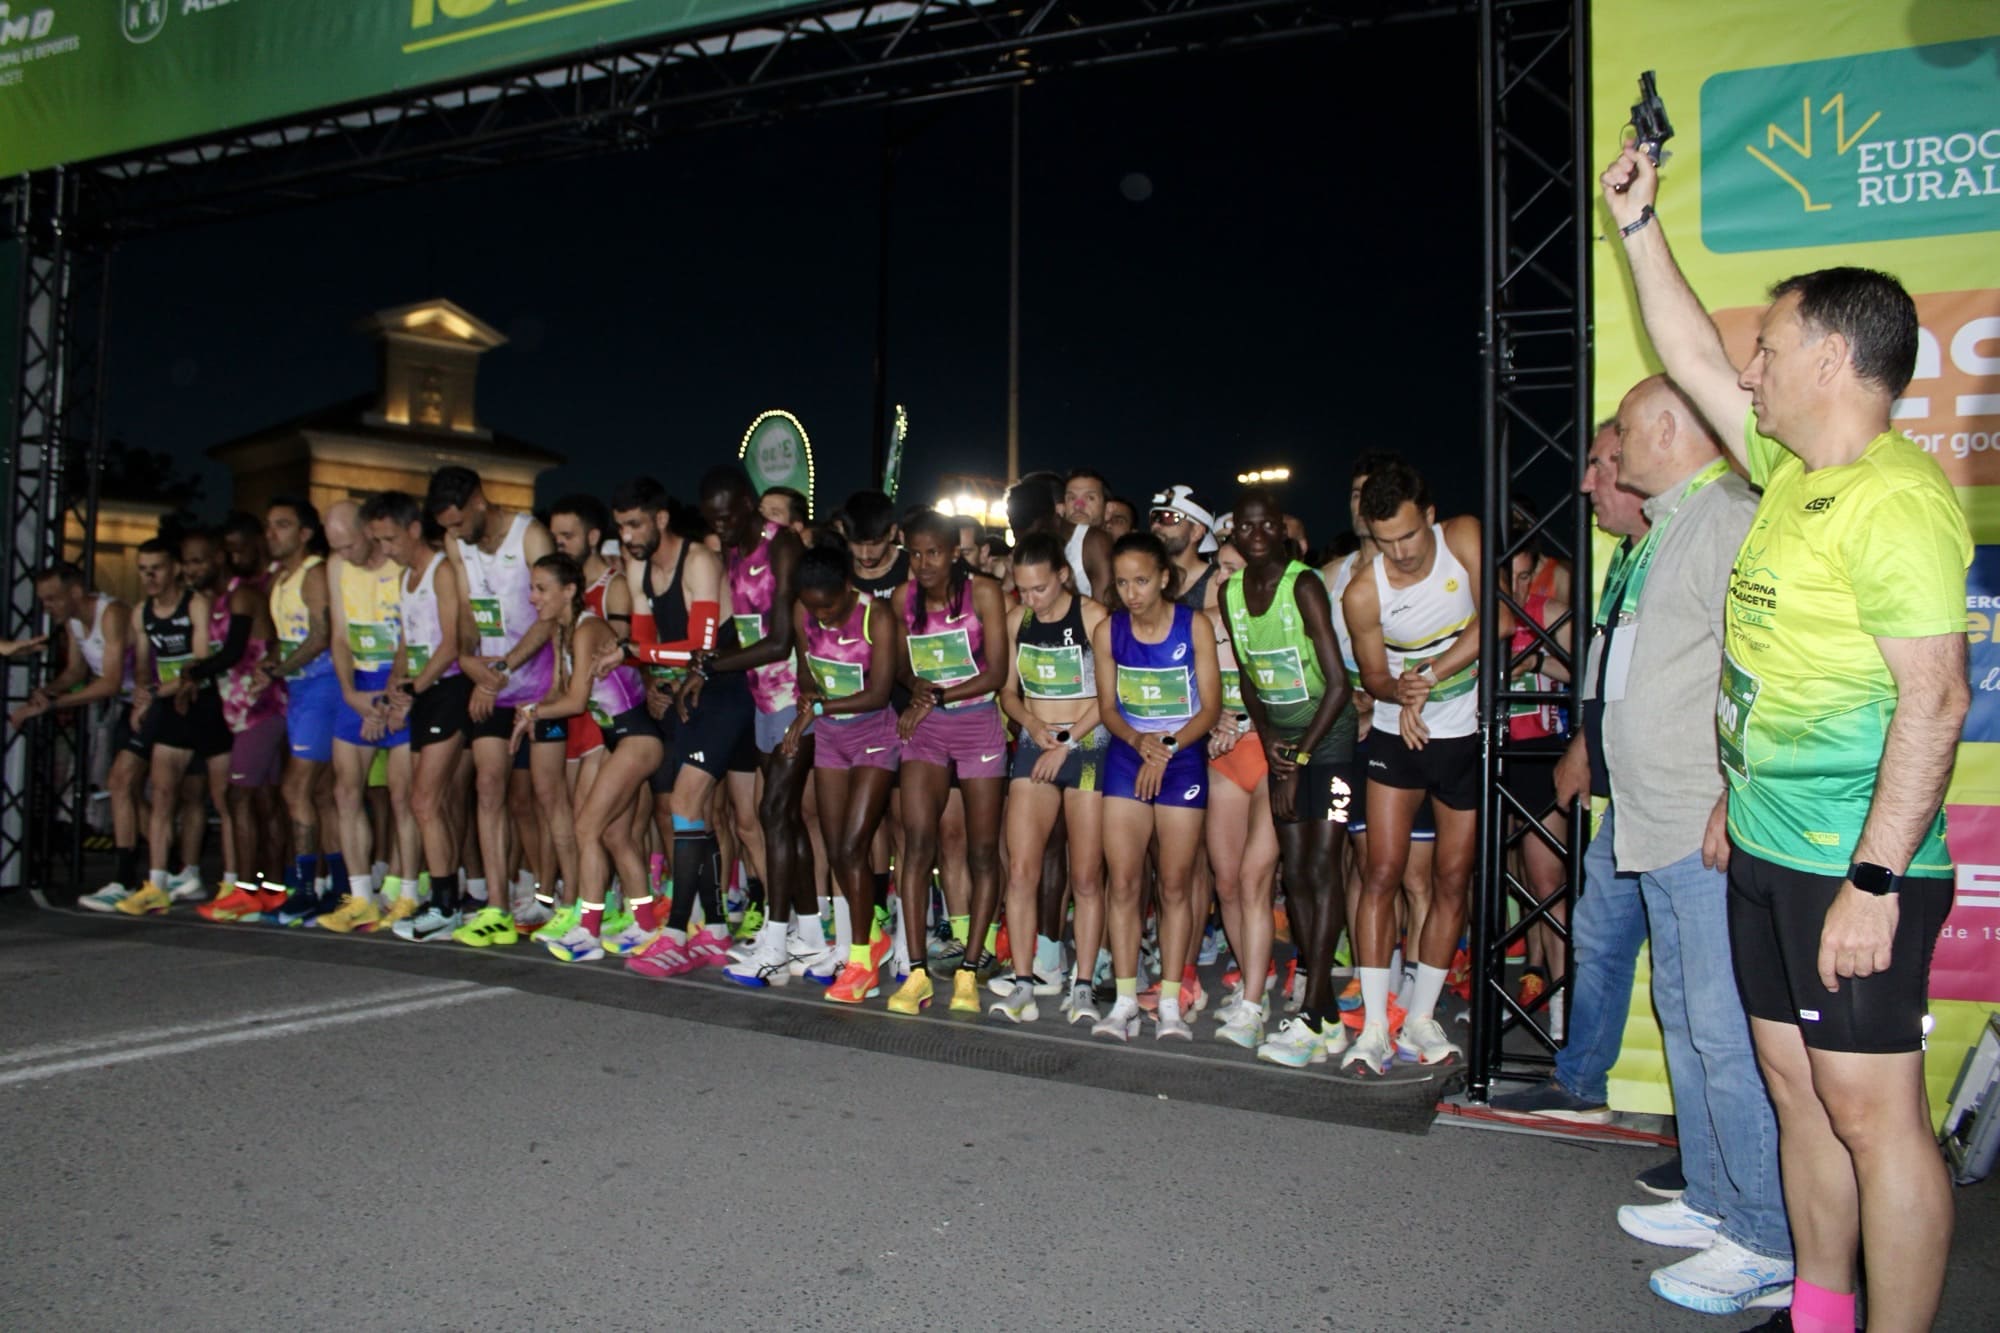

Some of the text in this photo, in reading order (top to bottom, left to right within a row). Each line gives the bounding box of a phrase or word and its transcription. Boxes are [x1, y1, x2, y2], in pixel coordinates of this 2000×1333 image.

[1857, 165, 2000, 207] RURAL
[1036, 664, 1057, 679] 13
[1256, 669, 1275, 684] 17
[1141, 685, 1162, 699] 12
